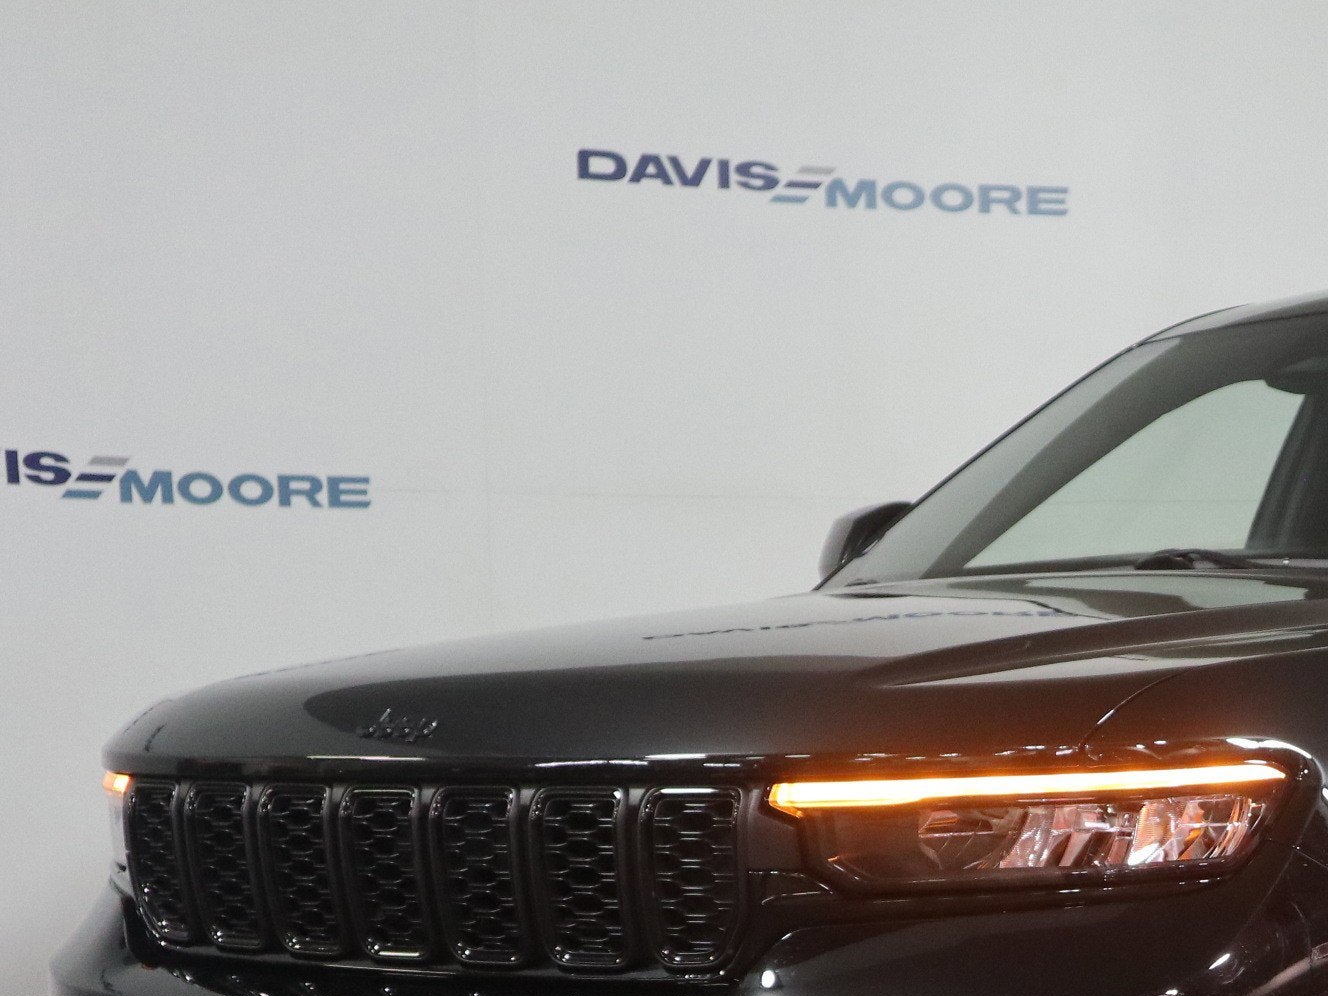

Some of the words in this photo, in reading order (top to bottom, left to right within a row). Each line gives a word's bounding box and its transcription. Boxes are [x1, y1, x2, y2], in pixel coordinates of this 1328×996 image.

[577, 149, 780, 191] DAVIS
[824, 178, 1069, 216] MOORE
[119, 469, 372, 508] MOORE
